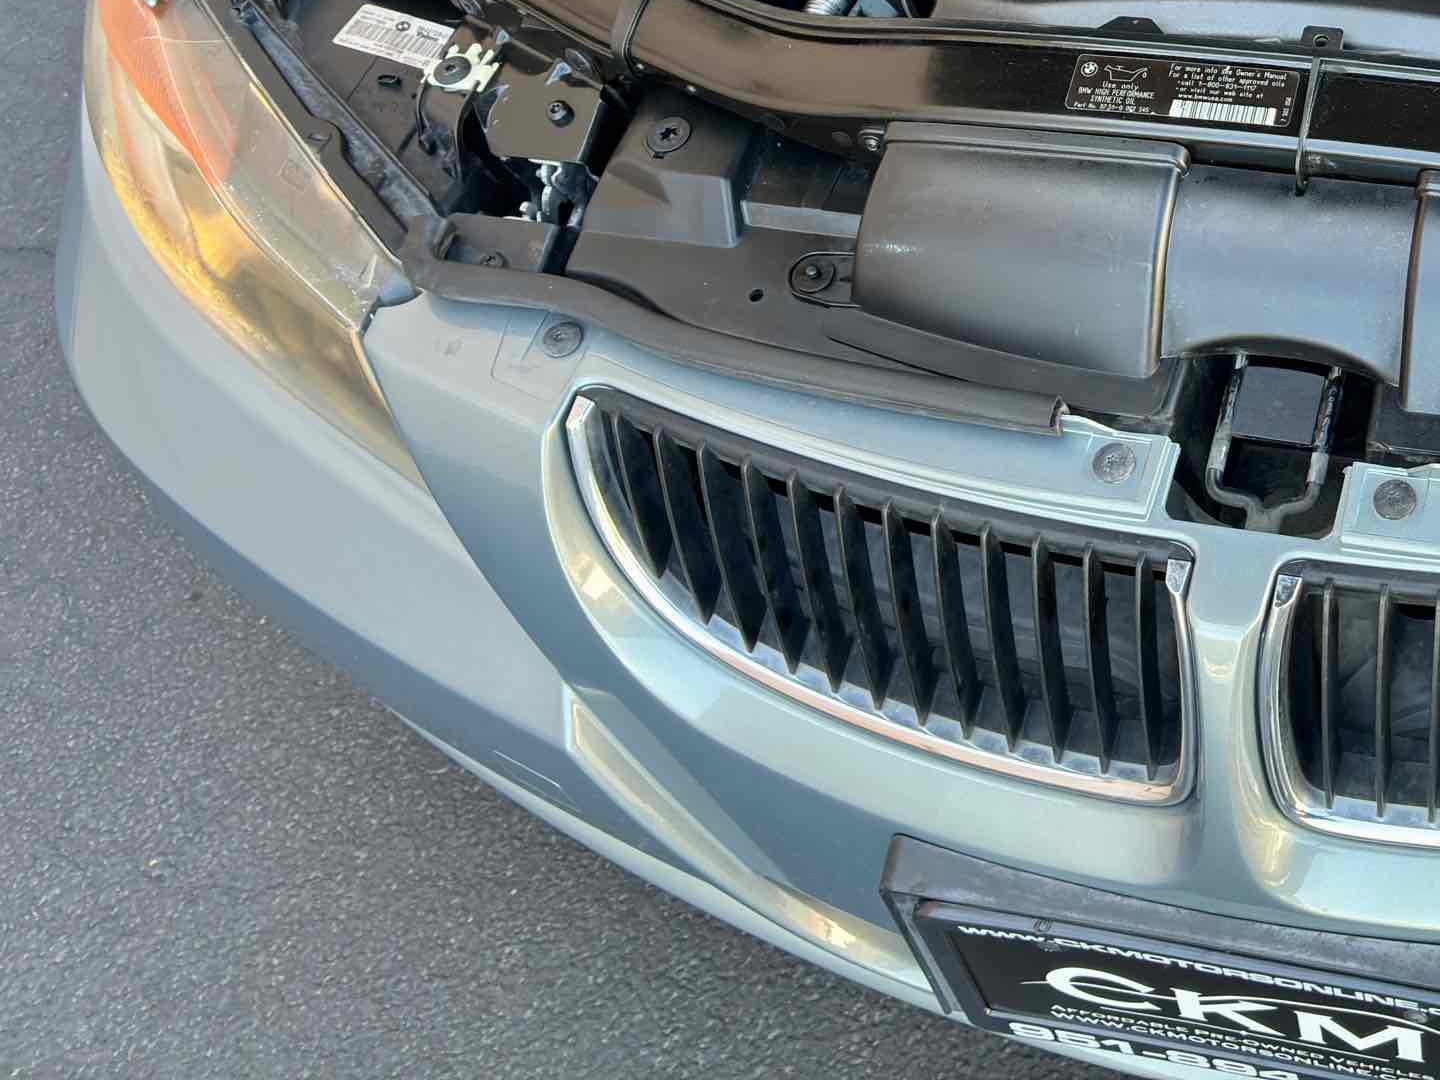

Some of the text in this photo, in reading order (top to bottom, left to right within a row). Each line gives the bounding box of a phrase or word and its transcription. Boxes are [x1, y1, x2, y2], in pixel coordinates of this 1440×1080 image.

[1168, 70, 1181, 78] For
[1191, 72, 1204, 80] list
[1217, 74, 1236, 82] other
[1239, 78, 1269, 86] approved
[1271, 80, 1285, 88] oils
[1235, 68, 1261, 78] Owner's
[1264, 72, 1287, 80] Manual
[1078, 86, 1155, 99] BMW HIGH PERFORMANCE
[1102, 81, 1139, 91] Use only
[1090, 95, 1123, 104] SYNTHETIC
[1044, 967, 1424, 1063] CKM
[1051, 1004, 1188, 1033] AFFORDABLE
[1329, 1055, 1435, 1080] VEHICLES
